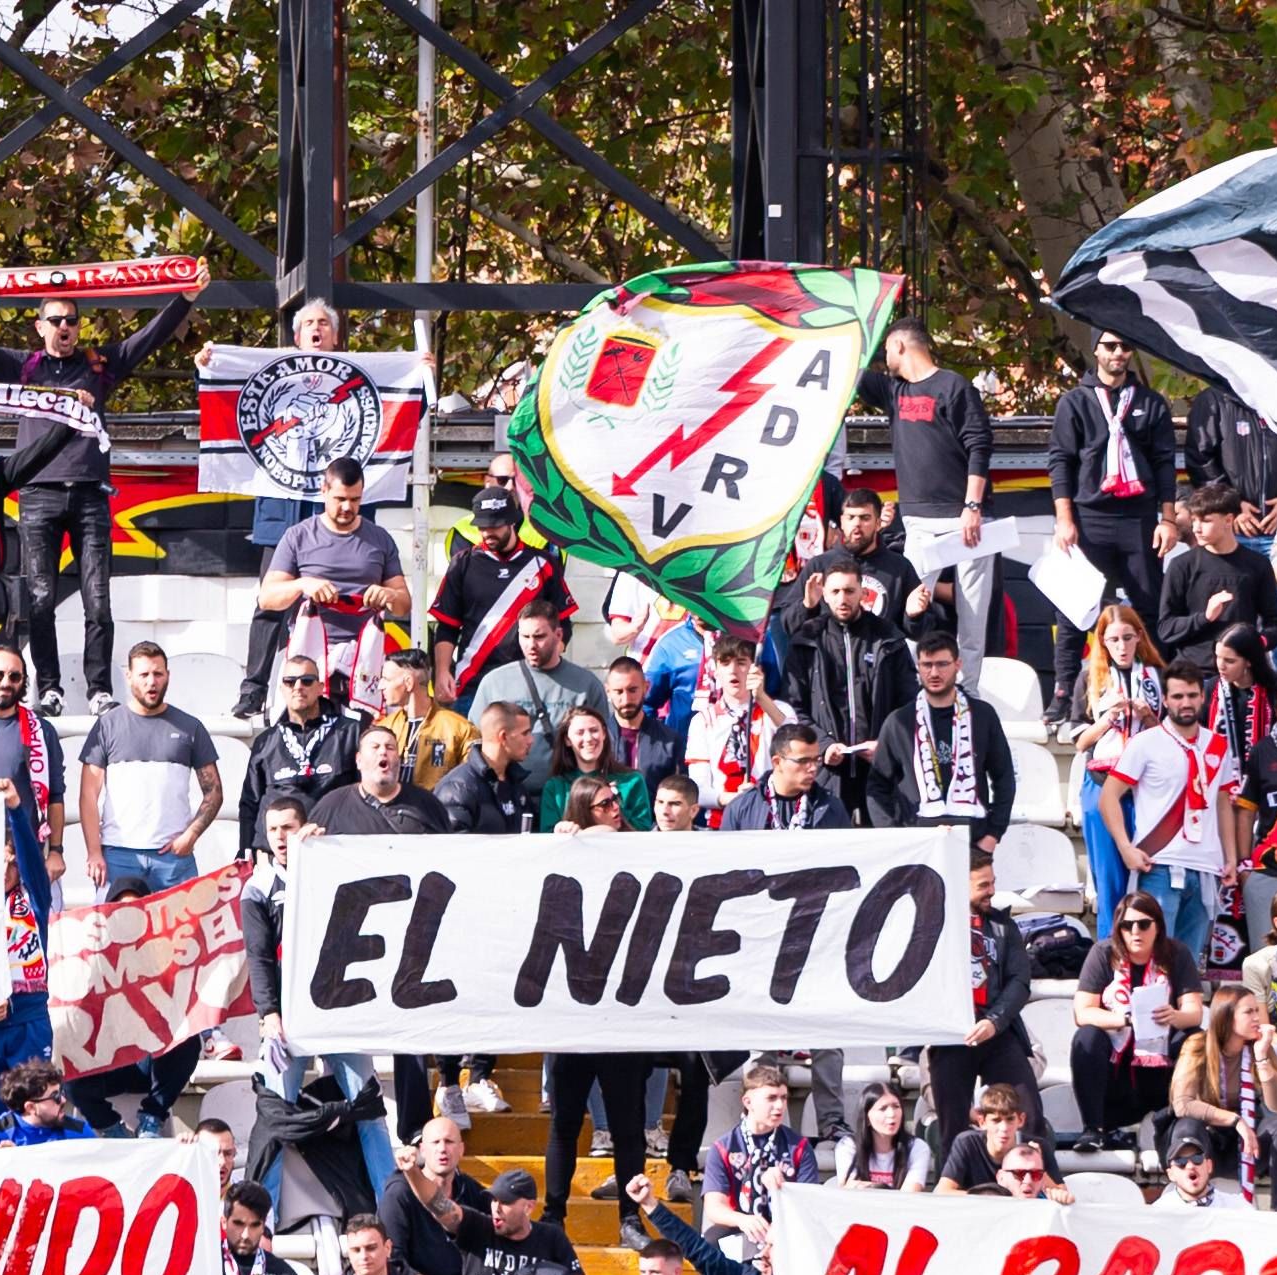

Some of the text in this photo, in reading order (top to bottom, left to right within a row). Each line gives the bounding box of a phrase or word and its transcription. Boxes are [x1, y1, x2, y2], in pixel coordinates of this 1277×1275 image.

[75, 259, 199, 289] RAYO
[274, 356, 353, 381] AMOR
[796, 349, 832, 391] A
[760, 405, 800, 447] D
[701, 451, 749, 500] R
[650, 494, 693, 540] V
[310, 864, 946, 1010] EL NIETO
